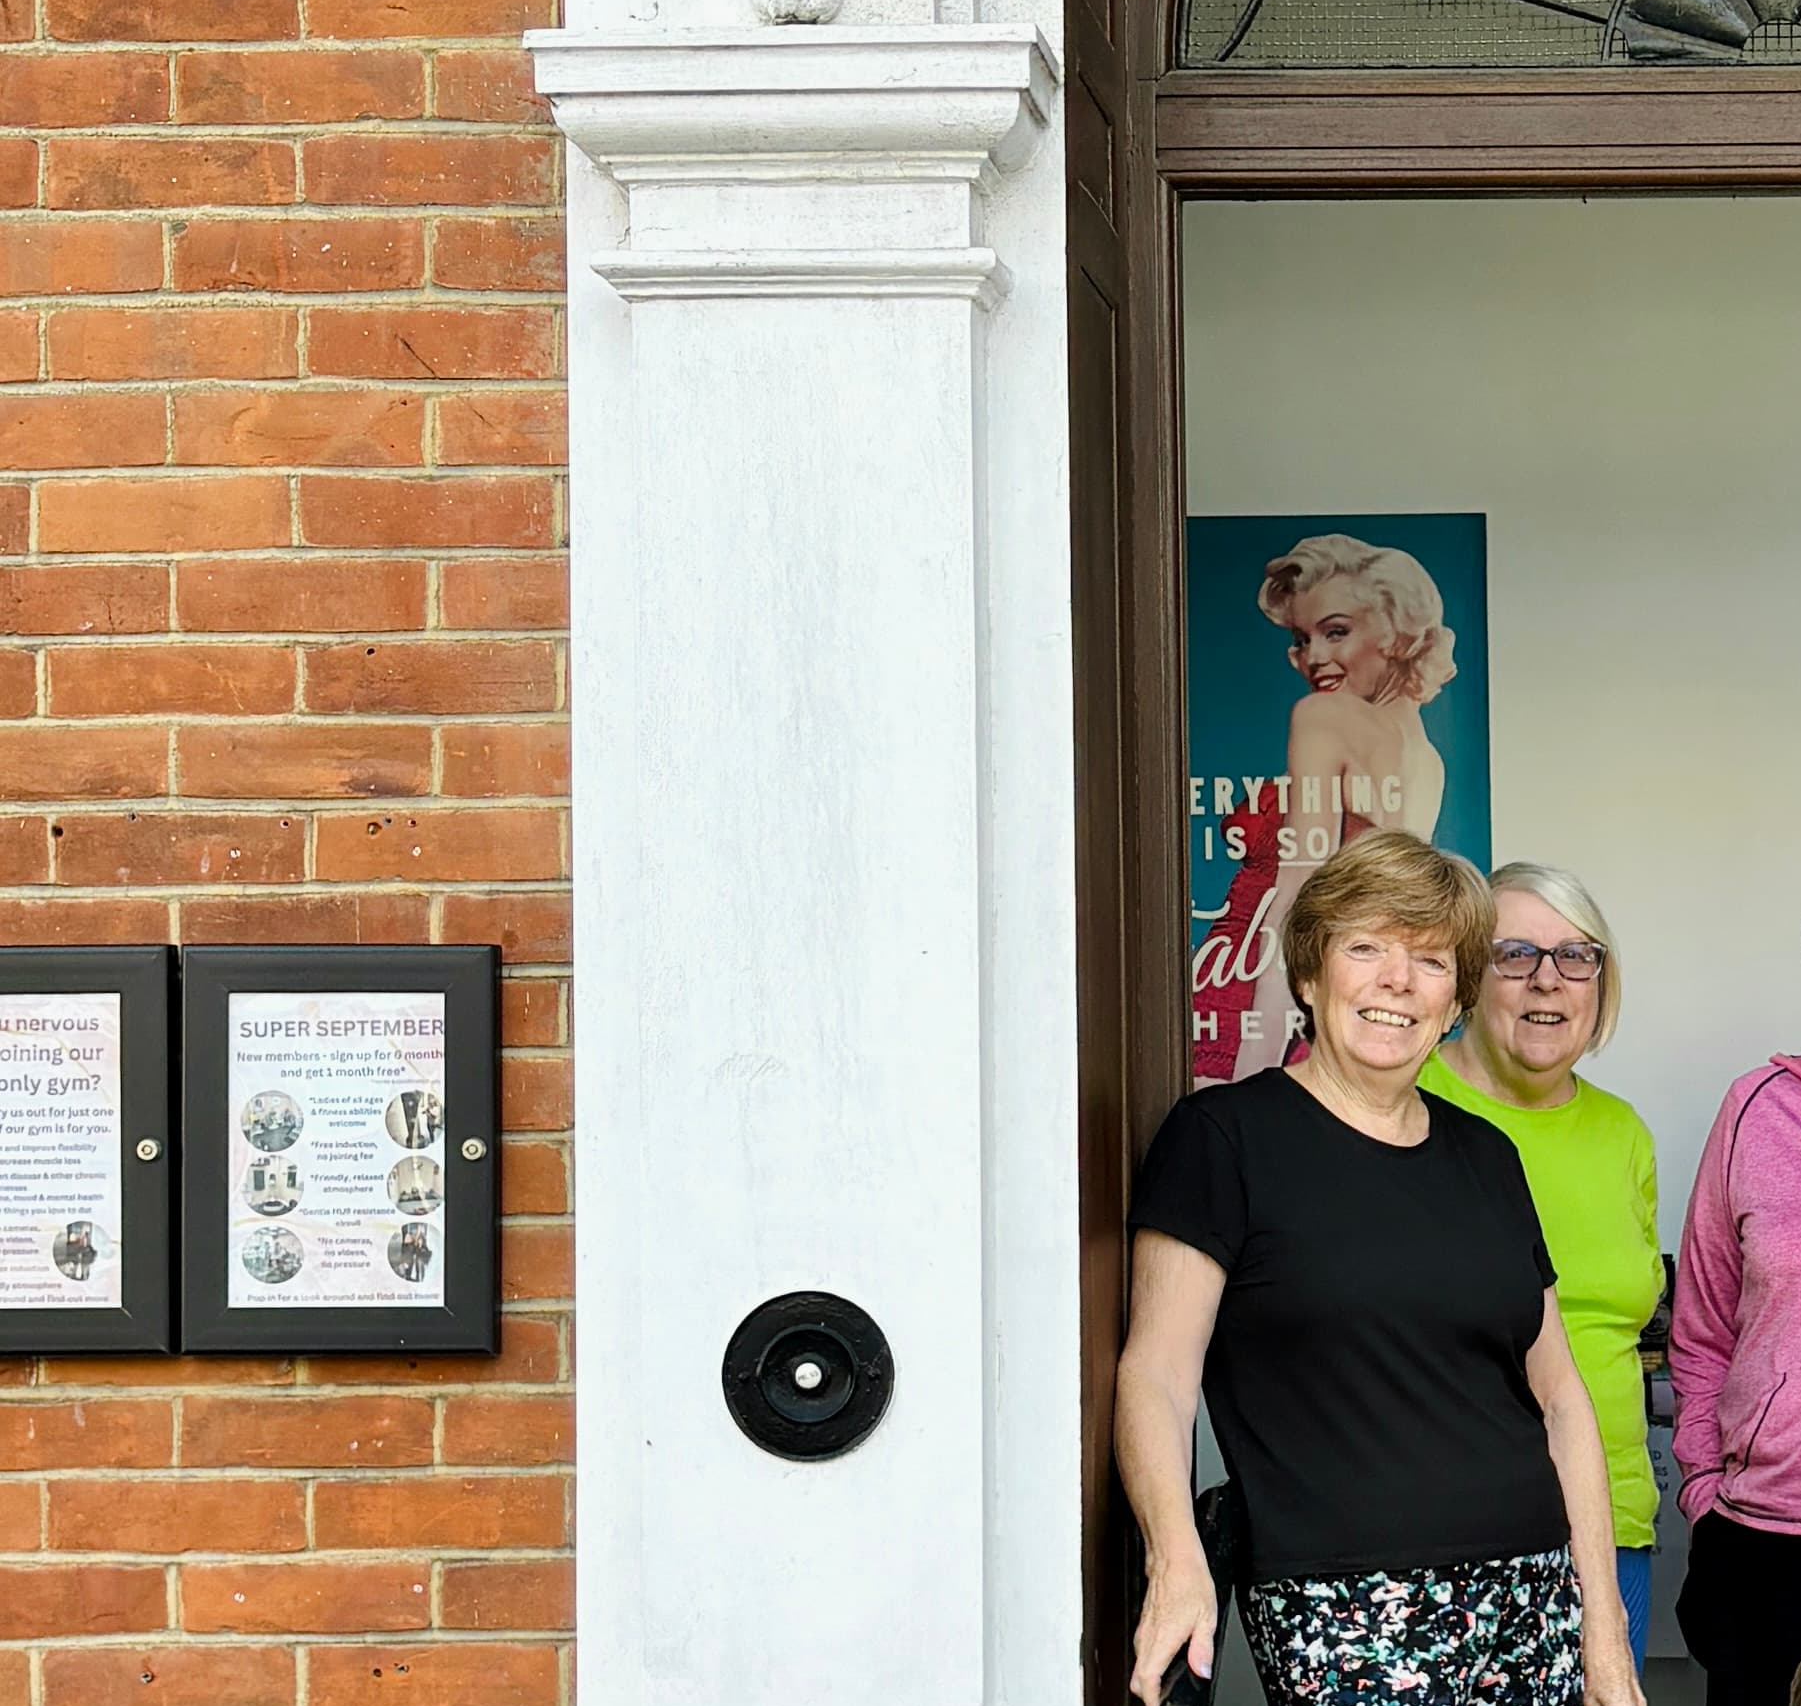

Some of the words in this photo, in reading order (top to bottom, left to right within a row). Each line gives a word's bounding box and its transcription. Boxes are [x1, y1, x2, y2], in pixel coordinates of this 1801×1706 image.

[1205, 826, 1247, 860] IS
[1277, 826, 1329, 860] SO
[16, 1018, 99, 1031] nervous
[240, 1021, 310, 1038] SUPER
[316, 1019, 444, 1037] SEPTEMBER
[0, 1044, 63, 1066] oining
[69, 1047, 104, 1061] our
[237, 1052, 263, 1062] New
[265, 1050, 320, 1062] members
[330, 1050, 353, 1064] sign
[356, 1052, 371, 1064] up
[374, 1050, 390, 1061] for
[281, 1066, 302, 1077] and
[305, 1067, 323, 1079] get
[326, 1067, 333, 1077] 1
[335, 1066, 374, 1077] month
[48, 1074, 101, 1095] gym?
[10, 1109, 24, 1117] us
[26, 1108, 46, 1117] out
[49, 1107, 65, 1117] for
[68, 1107, 90, 1119] just
[92, 1108, 114, 1117] one
[5, 1125, 24, 1133] our
[28, 1125, 52, 1135] gym
[55, 1123, 64, 1133] is
[67, 1123, 84, 1133] for
[86, 1125, 112, 1135] you.
